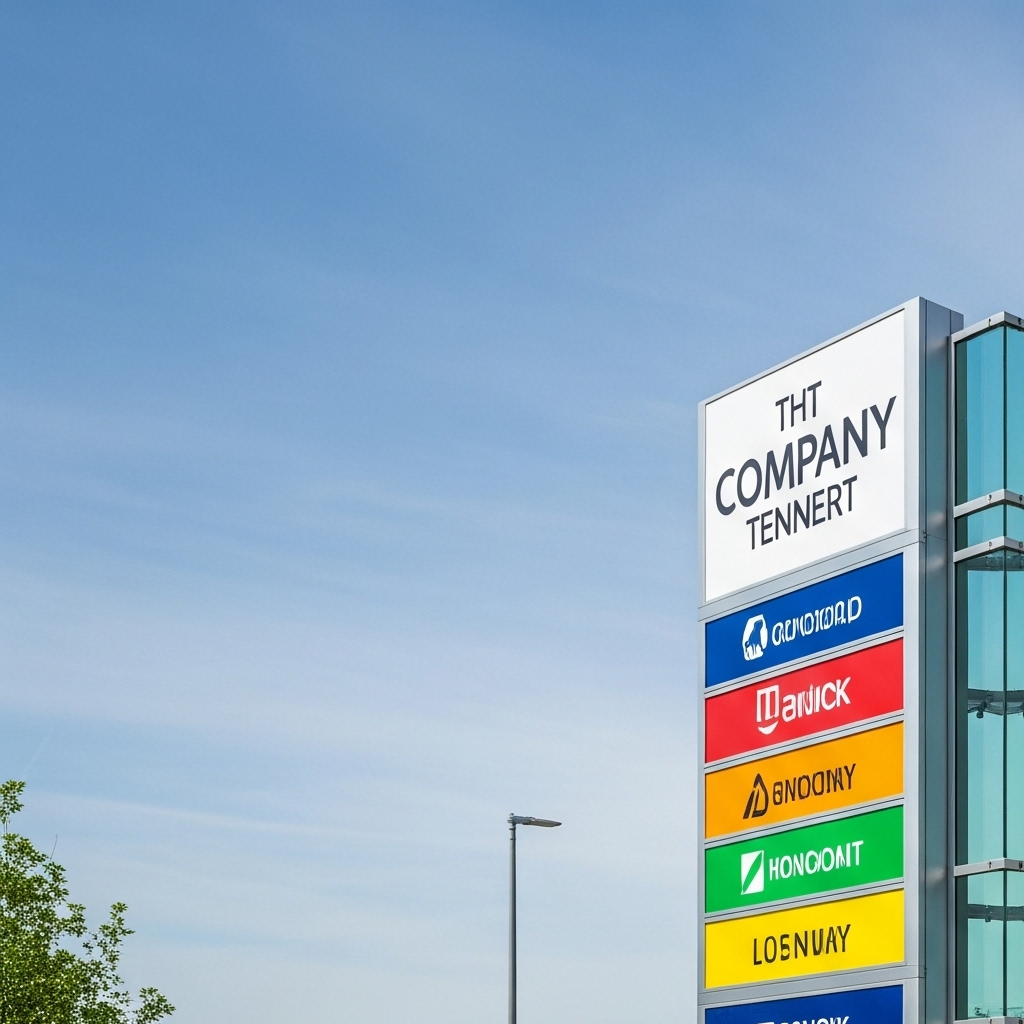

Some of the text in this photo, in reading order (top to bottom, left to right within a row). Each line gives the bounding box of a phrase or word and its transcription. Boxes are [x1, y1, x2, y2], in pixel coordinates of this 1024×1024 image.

[775, 380, 822, 432] THT
[715, 395, 897, 516] COMPANY
[746, 474, 858, 550] TENNERT
